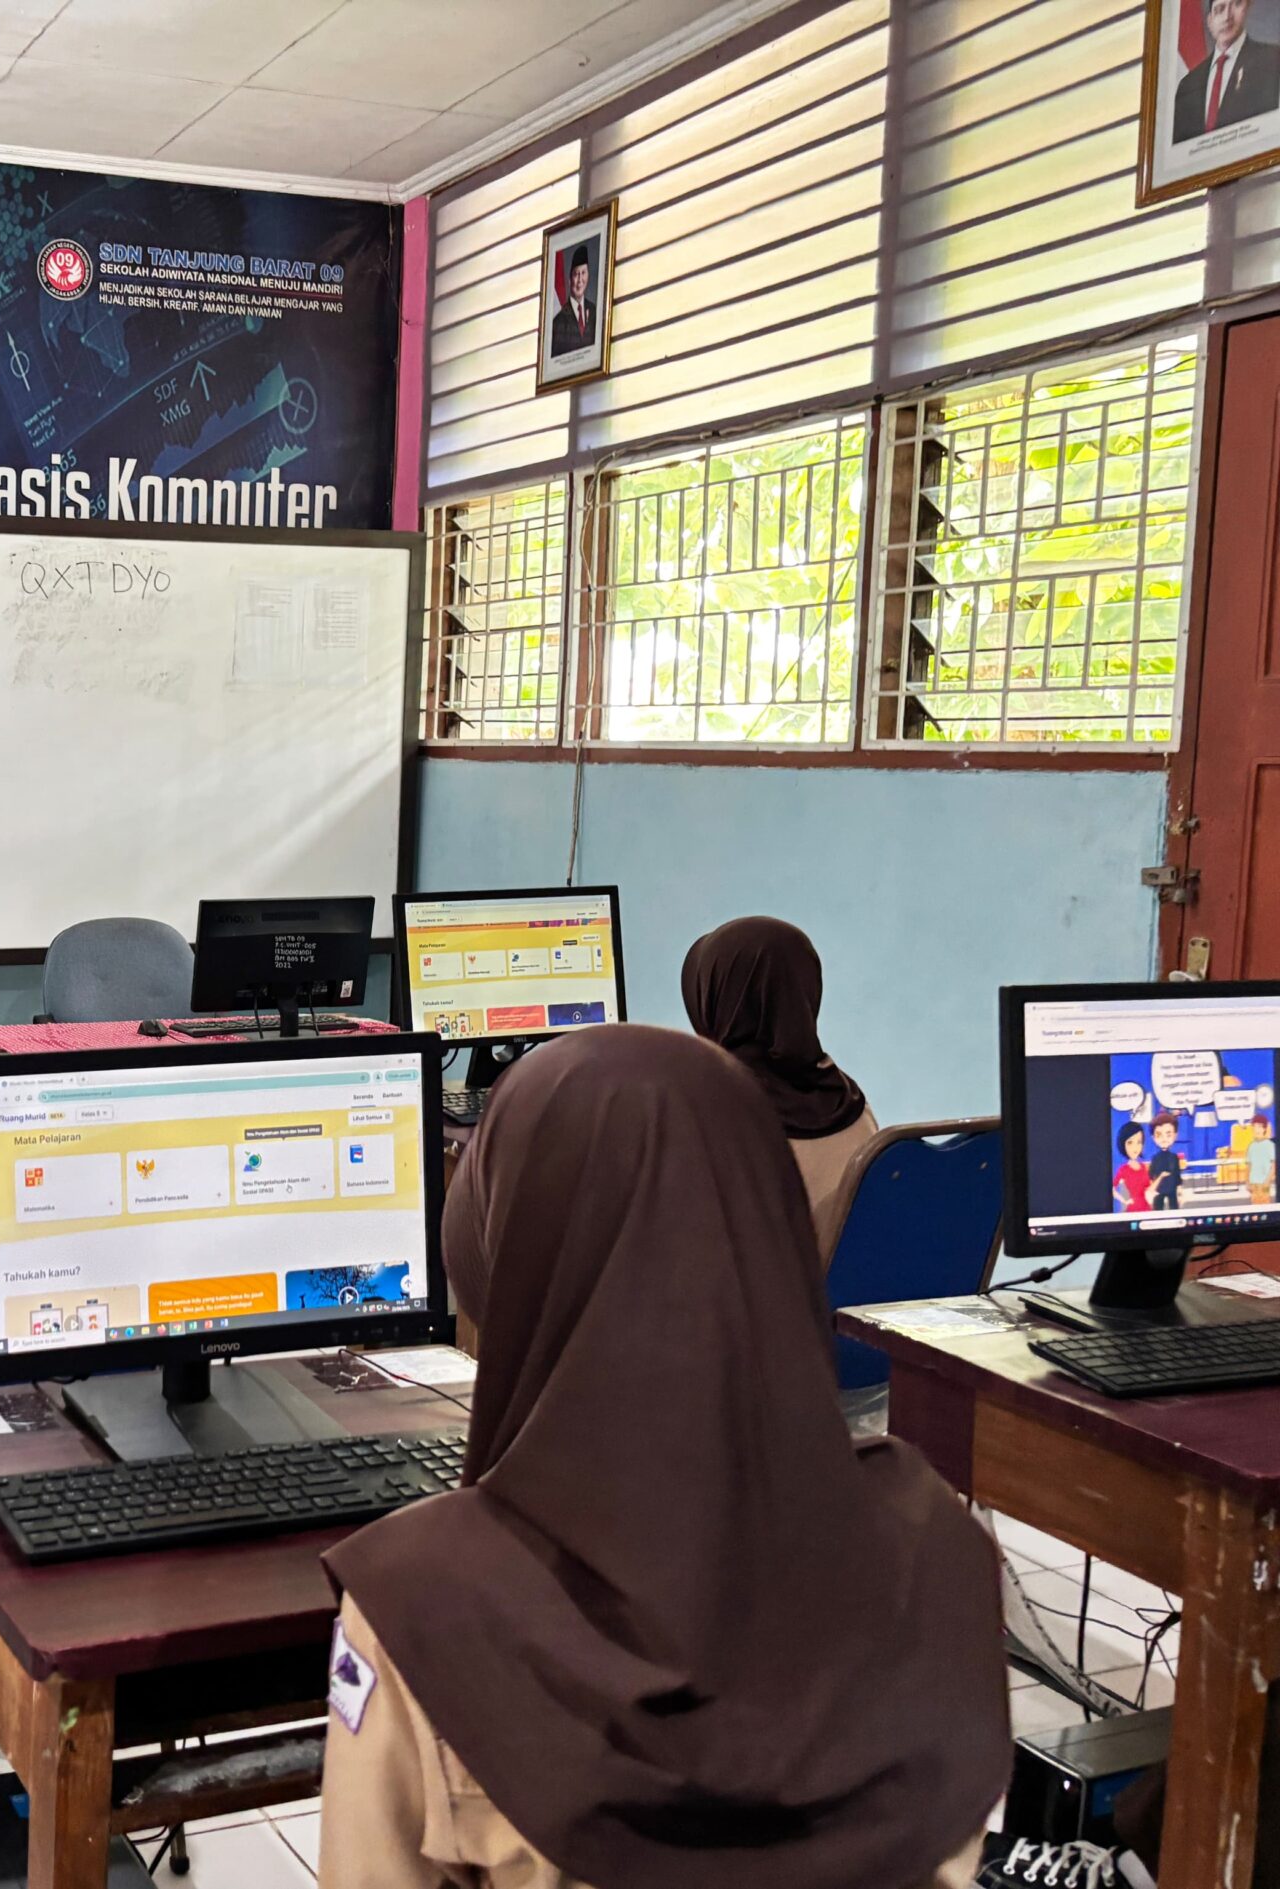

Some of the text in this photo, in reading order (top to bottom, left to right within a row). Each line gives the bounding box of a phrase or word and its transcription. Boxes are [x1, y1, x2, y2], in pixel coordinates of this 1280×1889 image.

[56, 252, 74, 267] 09
[99, 242, 344, 283] SDN TANJUNG BARAT 09
[100, 263, 343, 295] SEKOLAH ADIWIYATA NASIONAL MENUJU MANDIRI
[99, 282, 343, 313] MENJADIKAN SEKOLAH SARANA BELAJAR MENGAJAR YANG
[202, 304, 226, 314] AMAN
[228, 305, 245, 315] DAN
[247, 307, 282, 319] NYAMAN
[14, 1133, 81, 1146] Mata Pelajaran
[4, 1265, 81, 1282] Tahukah kamu?
[200, 1342, 240, 1355] Lenovo
